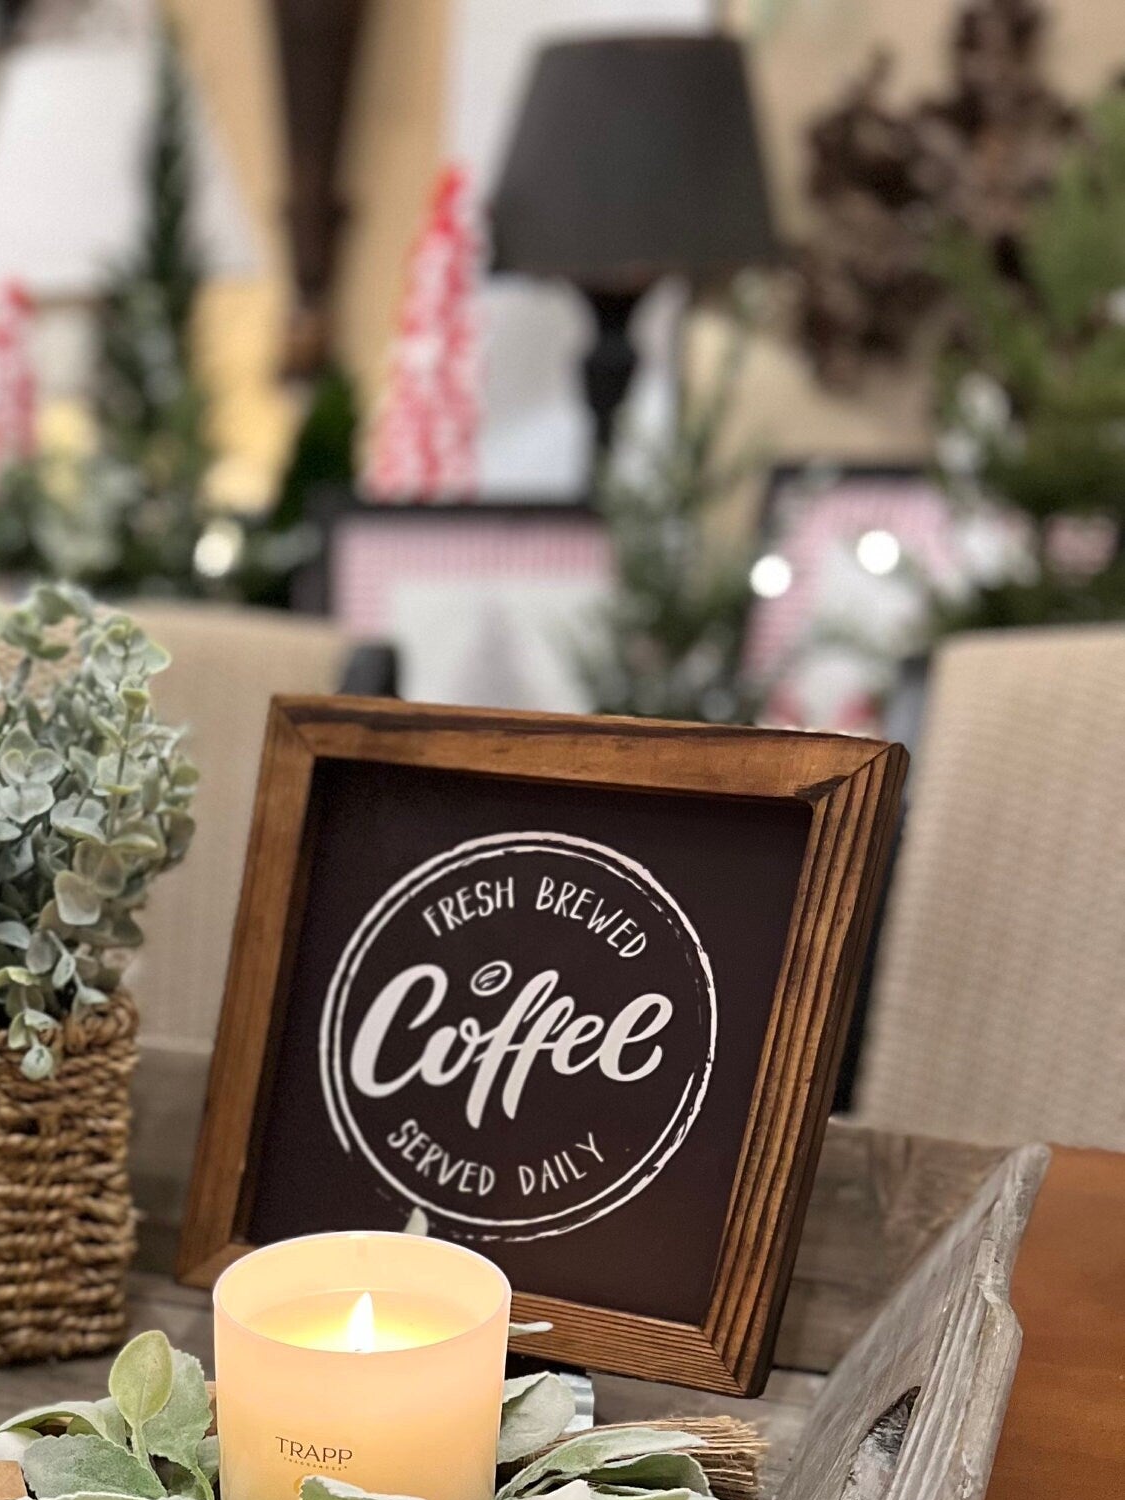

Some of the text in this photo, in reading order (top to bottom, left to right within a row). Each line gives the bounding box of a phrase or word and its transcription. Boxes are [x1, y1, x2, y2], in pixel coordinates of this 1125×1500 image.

[422, 876, 646, 958] FRESH BREWED
[350, 964, 673, 1128] Coffee
[387, 1118, 605, 1196] SERVED DAILY
[275, 1436, 353, 1464] TRAPP
